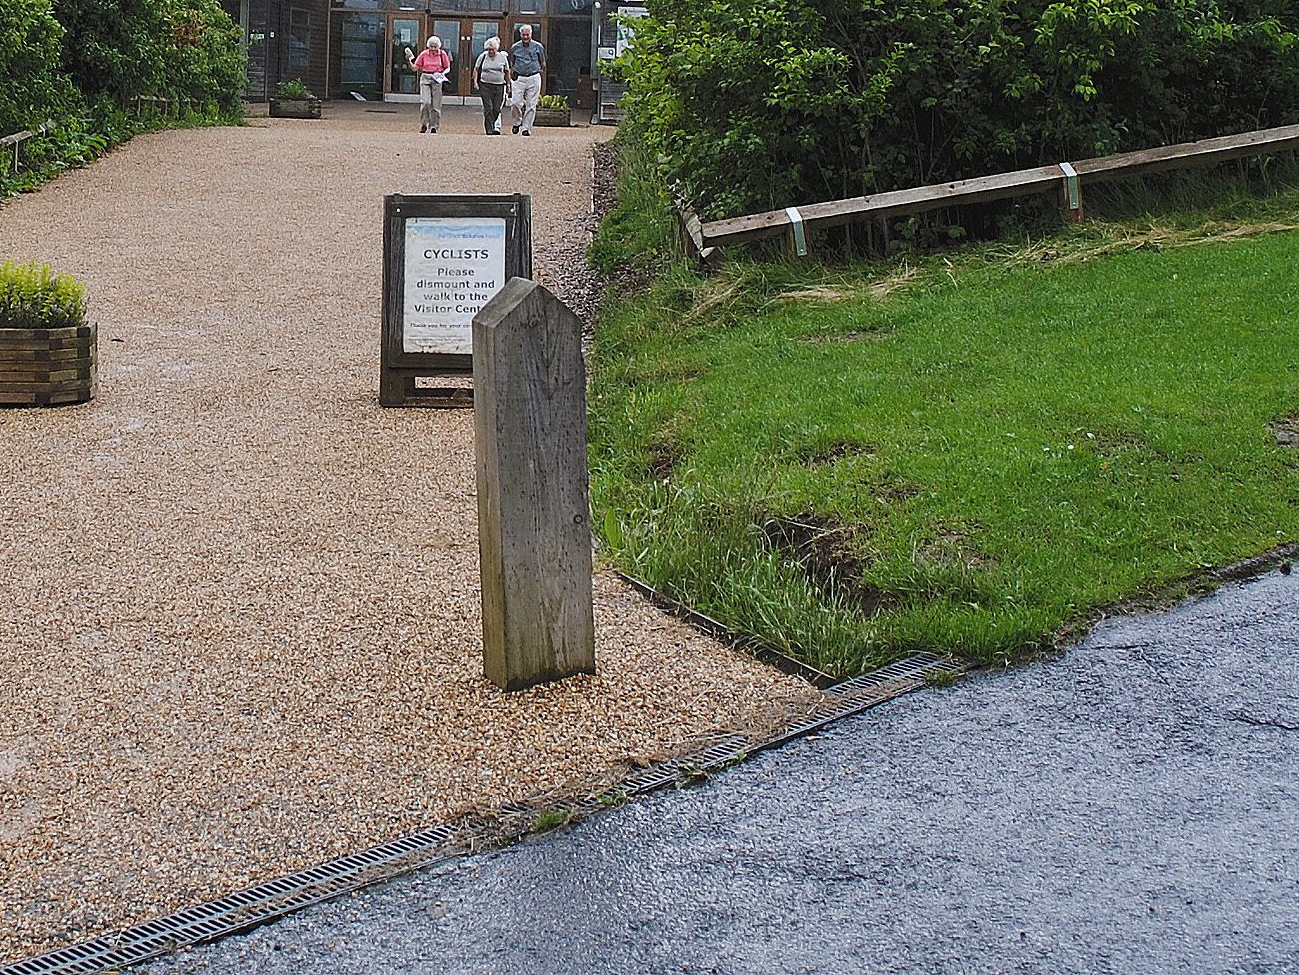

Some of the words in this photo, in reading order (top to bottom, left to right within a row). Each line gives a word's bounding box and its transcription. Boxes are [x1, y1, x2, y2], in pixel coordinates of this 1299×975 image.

[423, 249, 489, 259] CYCLISTS
[437, 267, 475, 277] Please
[416, 279, 470, 289] dismount
[473, 280, 495, 289] and
[423, 292, 451, 301] walk
[454, 293, 466, 301] to
[469, 292, 488, 301] the
[414, 304, 452, 313] Visitor
[455, 304, 482, 313] Cent
